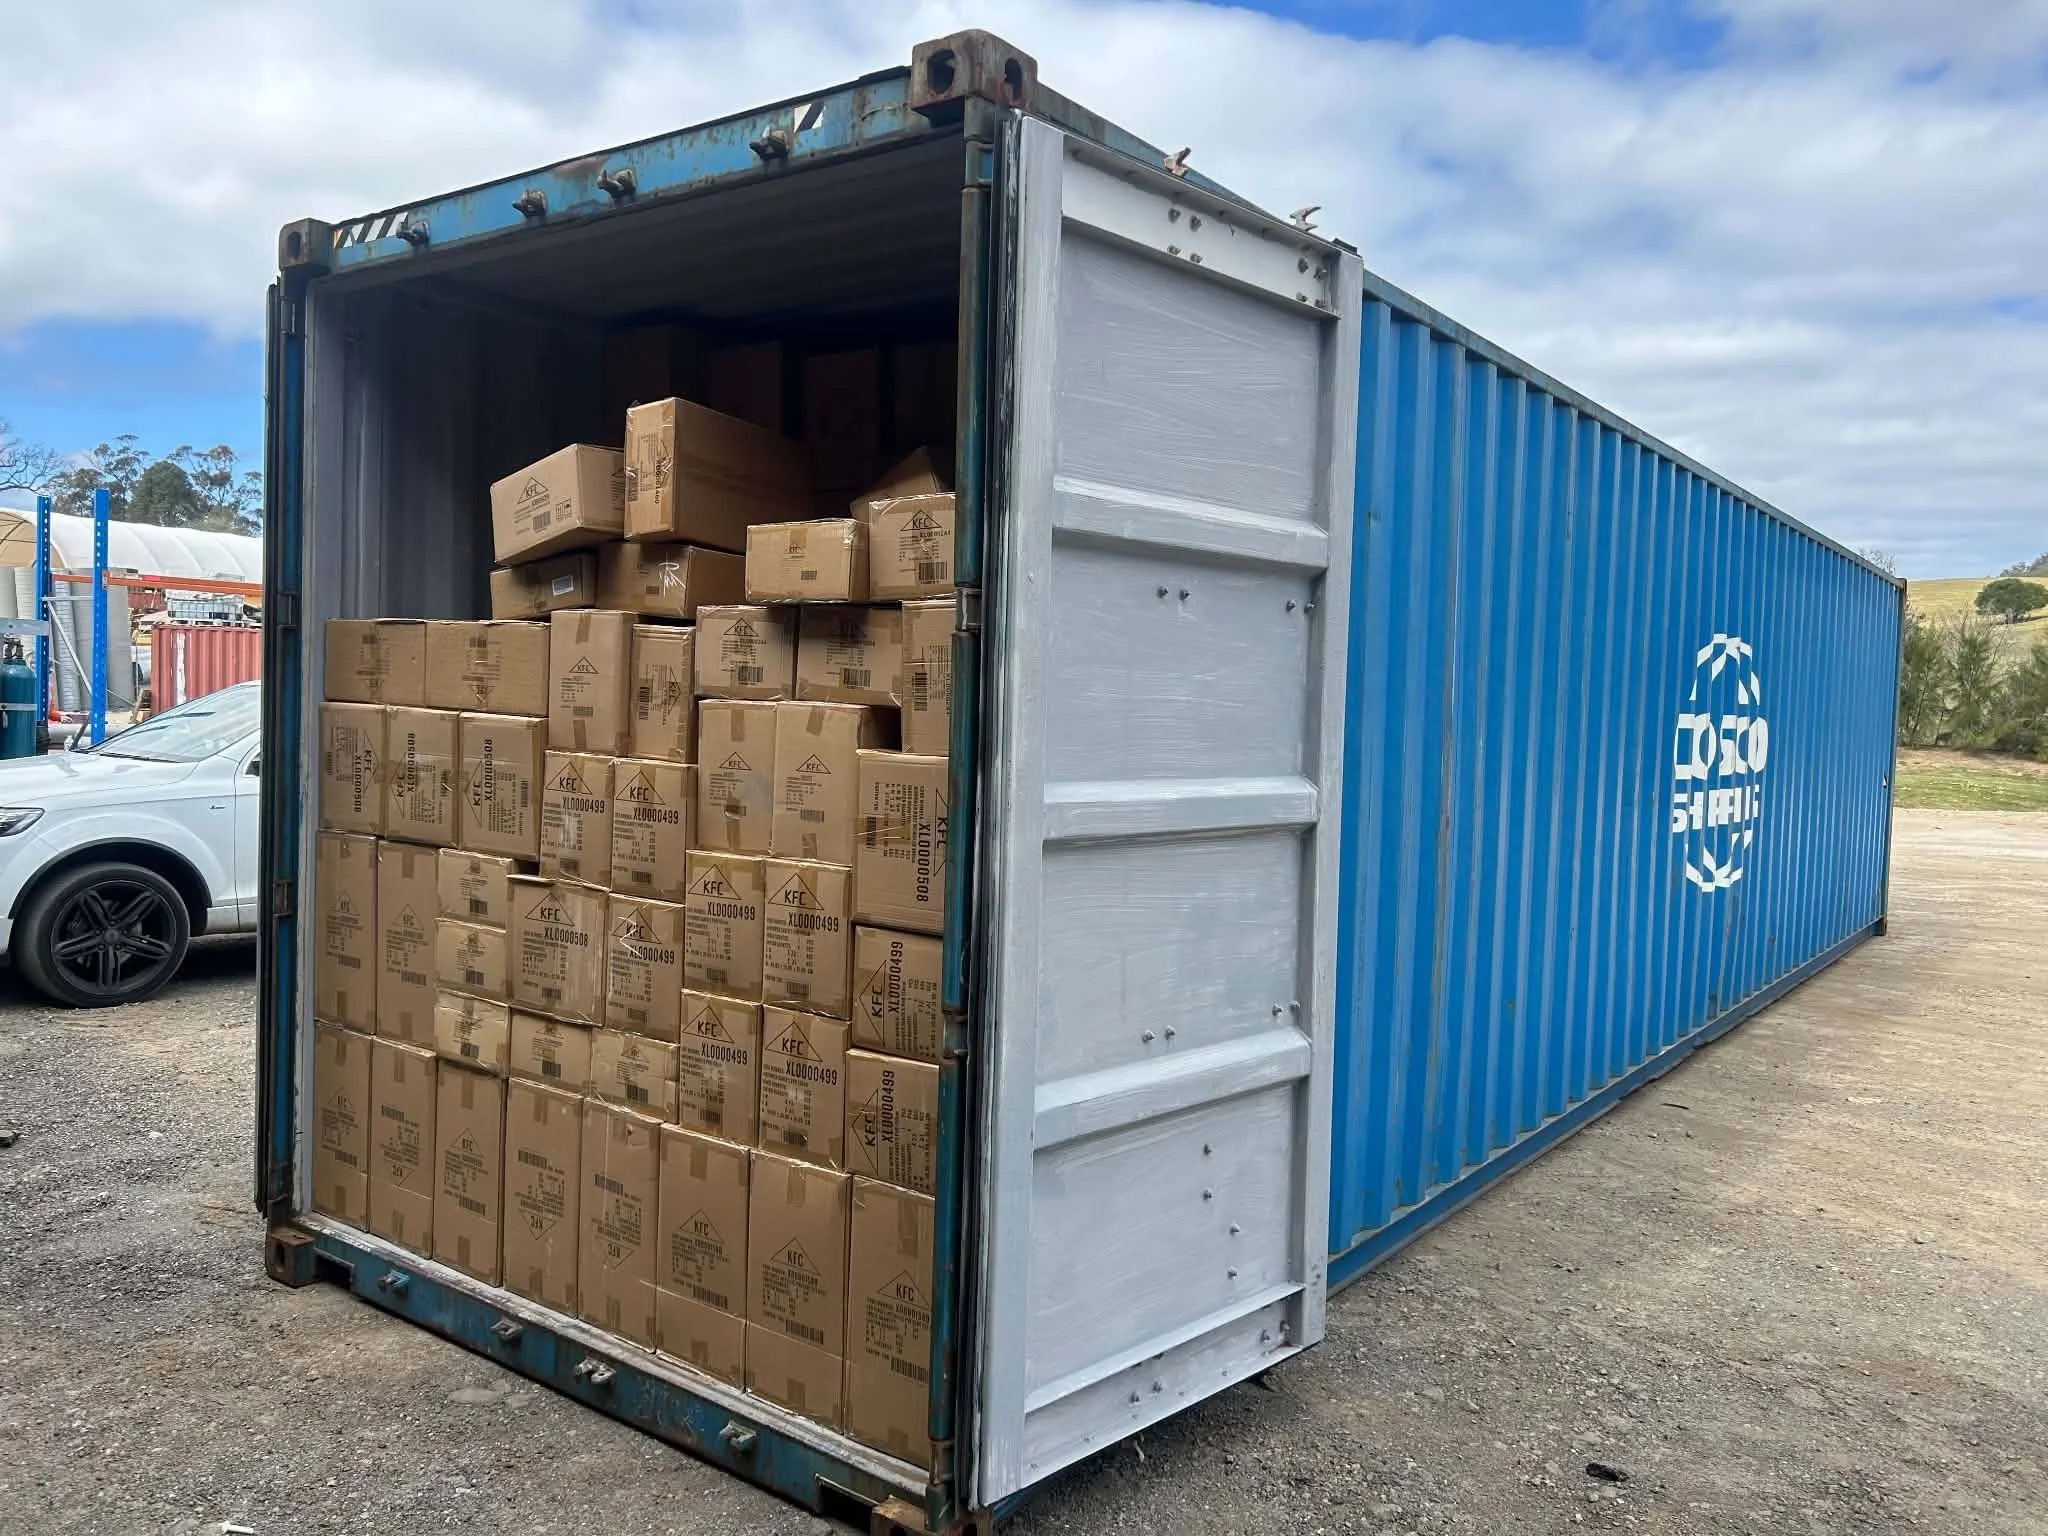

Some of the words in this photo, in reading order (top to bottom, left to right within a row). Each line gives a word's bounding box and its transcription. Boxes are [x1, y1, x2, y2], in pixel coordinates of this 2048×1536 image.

[525, 483, 538, 497] KFC
[912, 518, 929, 529] KFC
[577, 661, 592, 672] KFC
[363, 749, 372, 773] KFC
[406, 732, 416, 793] XL0000508
[483, 738, 493, 802] XL0000508
[728, 760, 742, 769] KFC
[806, 762, 821, 772] KFC
[396, 773, 405, 798] KFC
[559, 776, 577, 791] KFC
[472, 781, 481, 806] KFC
[629, 786, 649, 801] KFC
[562, 796, 605, 814] XL0000499
[633, 807, 679, 825] XL0000499
[916, 822, 931, 902] XL0000508
[703, 880, 723, 896] KFC
[784, 889, 806, 906] KFC
[540, 907, 561, 922] KFC
[707, 901, 756, 921] XL0000499
[626, 923, 644, 939] KFC
[788, 911, 839, 933] XL0000499
[544, 927, 589, 947] XL0000508
[629, 944, 675, 965] XL0000499
[887, 941, 903, 1014] XL0000499
[871, 984, 883, 1018] KFC
[697, 1021, 717, 1038] KFC
[701, 1042, 748, 1065] XL0000499
[781, 1037, 804, 1055] KFC
[785, 1060, 838, 1086] XL0000499
[881, 1070, 895, 1143] XL0000499
[864, 1112, 876, 1146] KFC
[694, 1220, 709, 1236] KFC
[787, 1249, 804, 1267] KFC
[896, 1282, 914, 1301] KFC
